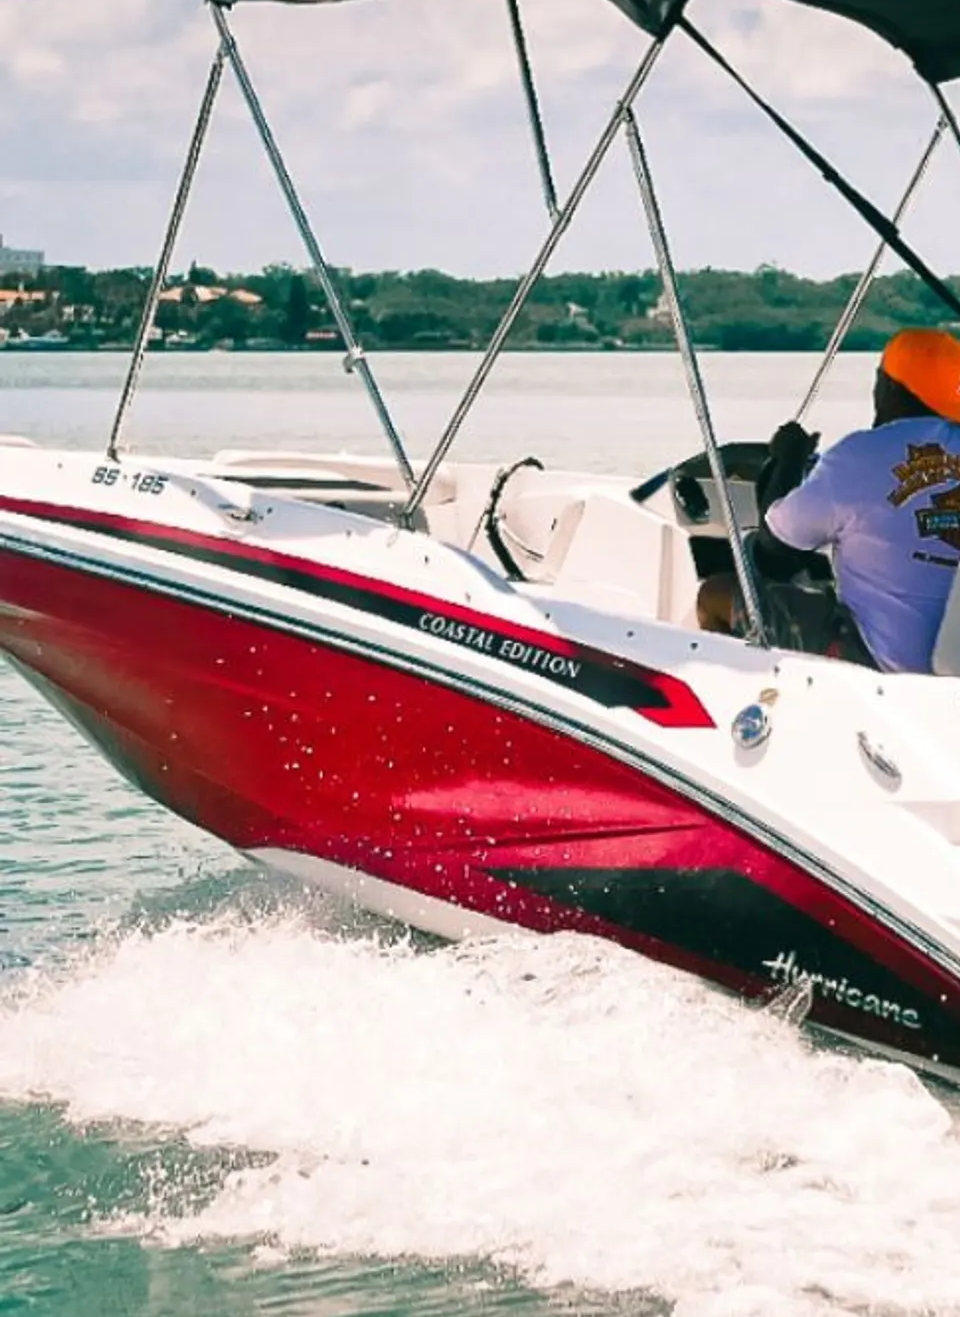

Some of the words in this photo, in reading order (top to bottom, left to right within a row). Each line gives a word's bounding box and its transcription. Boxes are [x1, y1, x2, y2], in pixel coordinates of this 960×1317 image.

[419, 613, 493, 650] COASTAL
[499, 640, 581, 678] EDITION
[762, 951, 922, 1029] Hurricane
